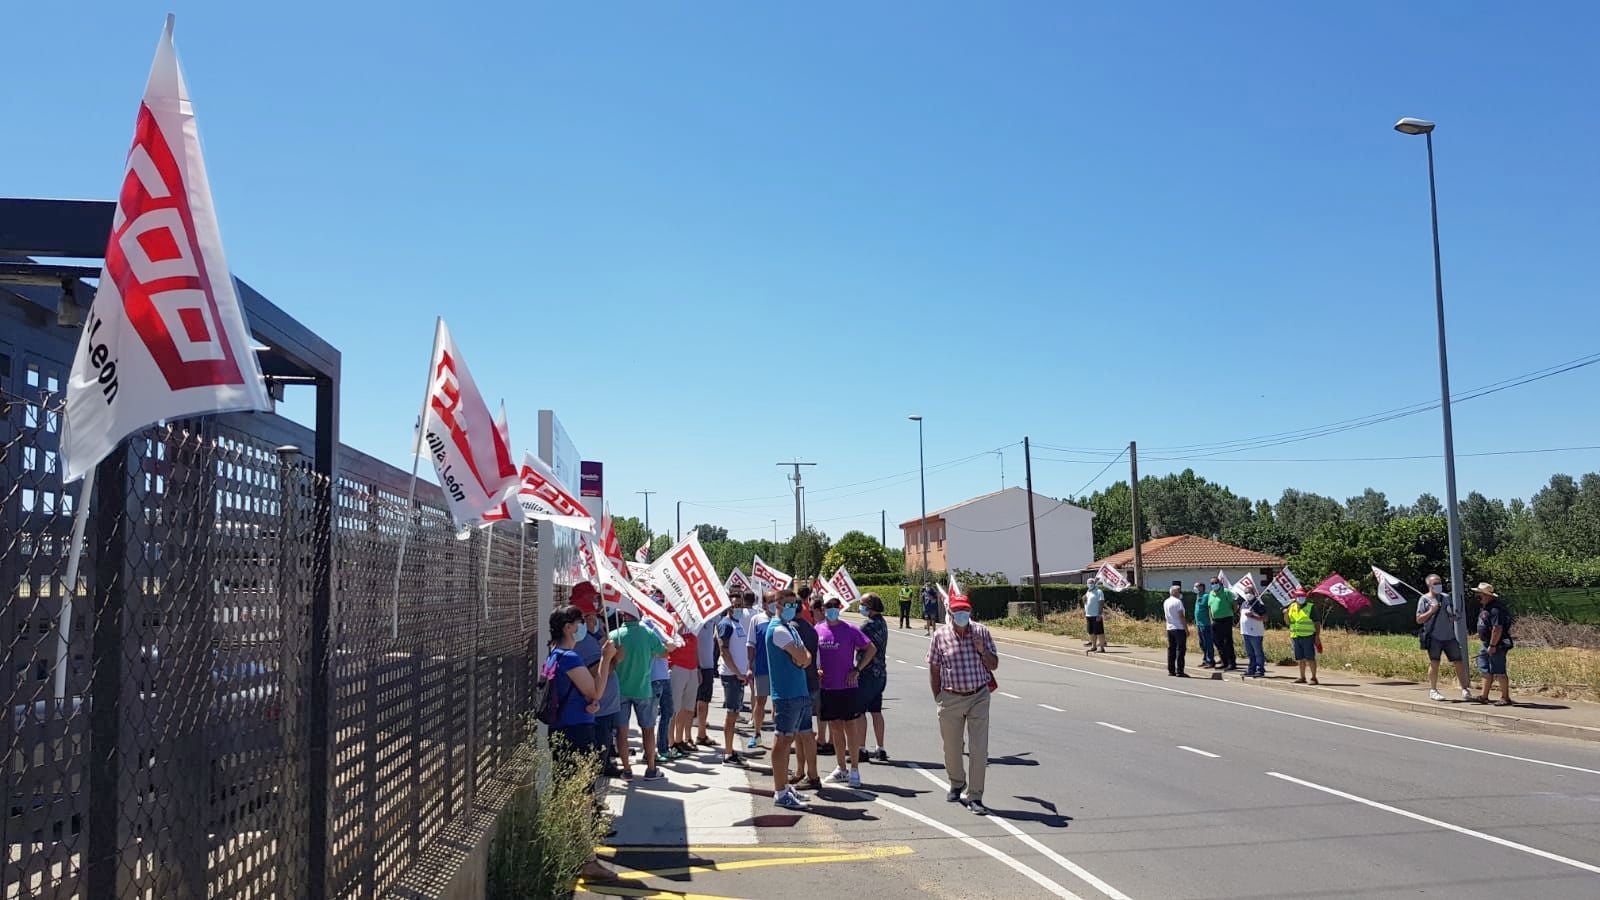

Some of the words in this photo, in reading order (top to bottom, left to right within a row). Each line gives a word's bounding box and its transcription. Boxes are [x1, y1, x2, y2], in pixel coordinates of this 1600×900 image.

[88, 318, 119, 406] León
[443, 464, 466, 502] León
[662, 567, 684, 598] Castilla
[677, 550, 716, 613] CCOO
[754, 565, 785, 591] CCOO
